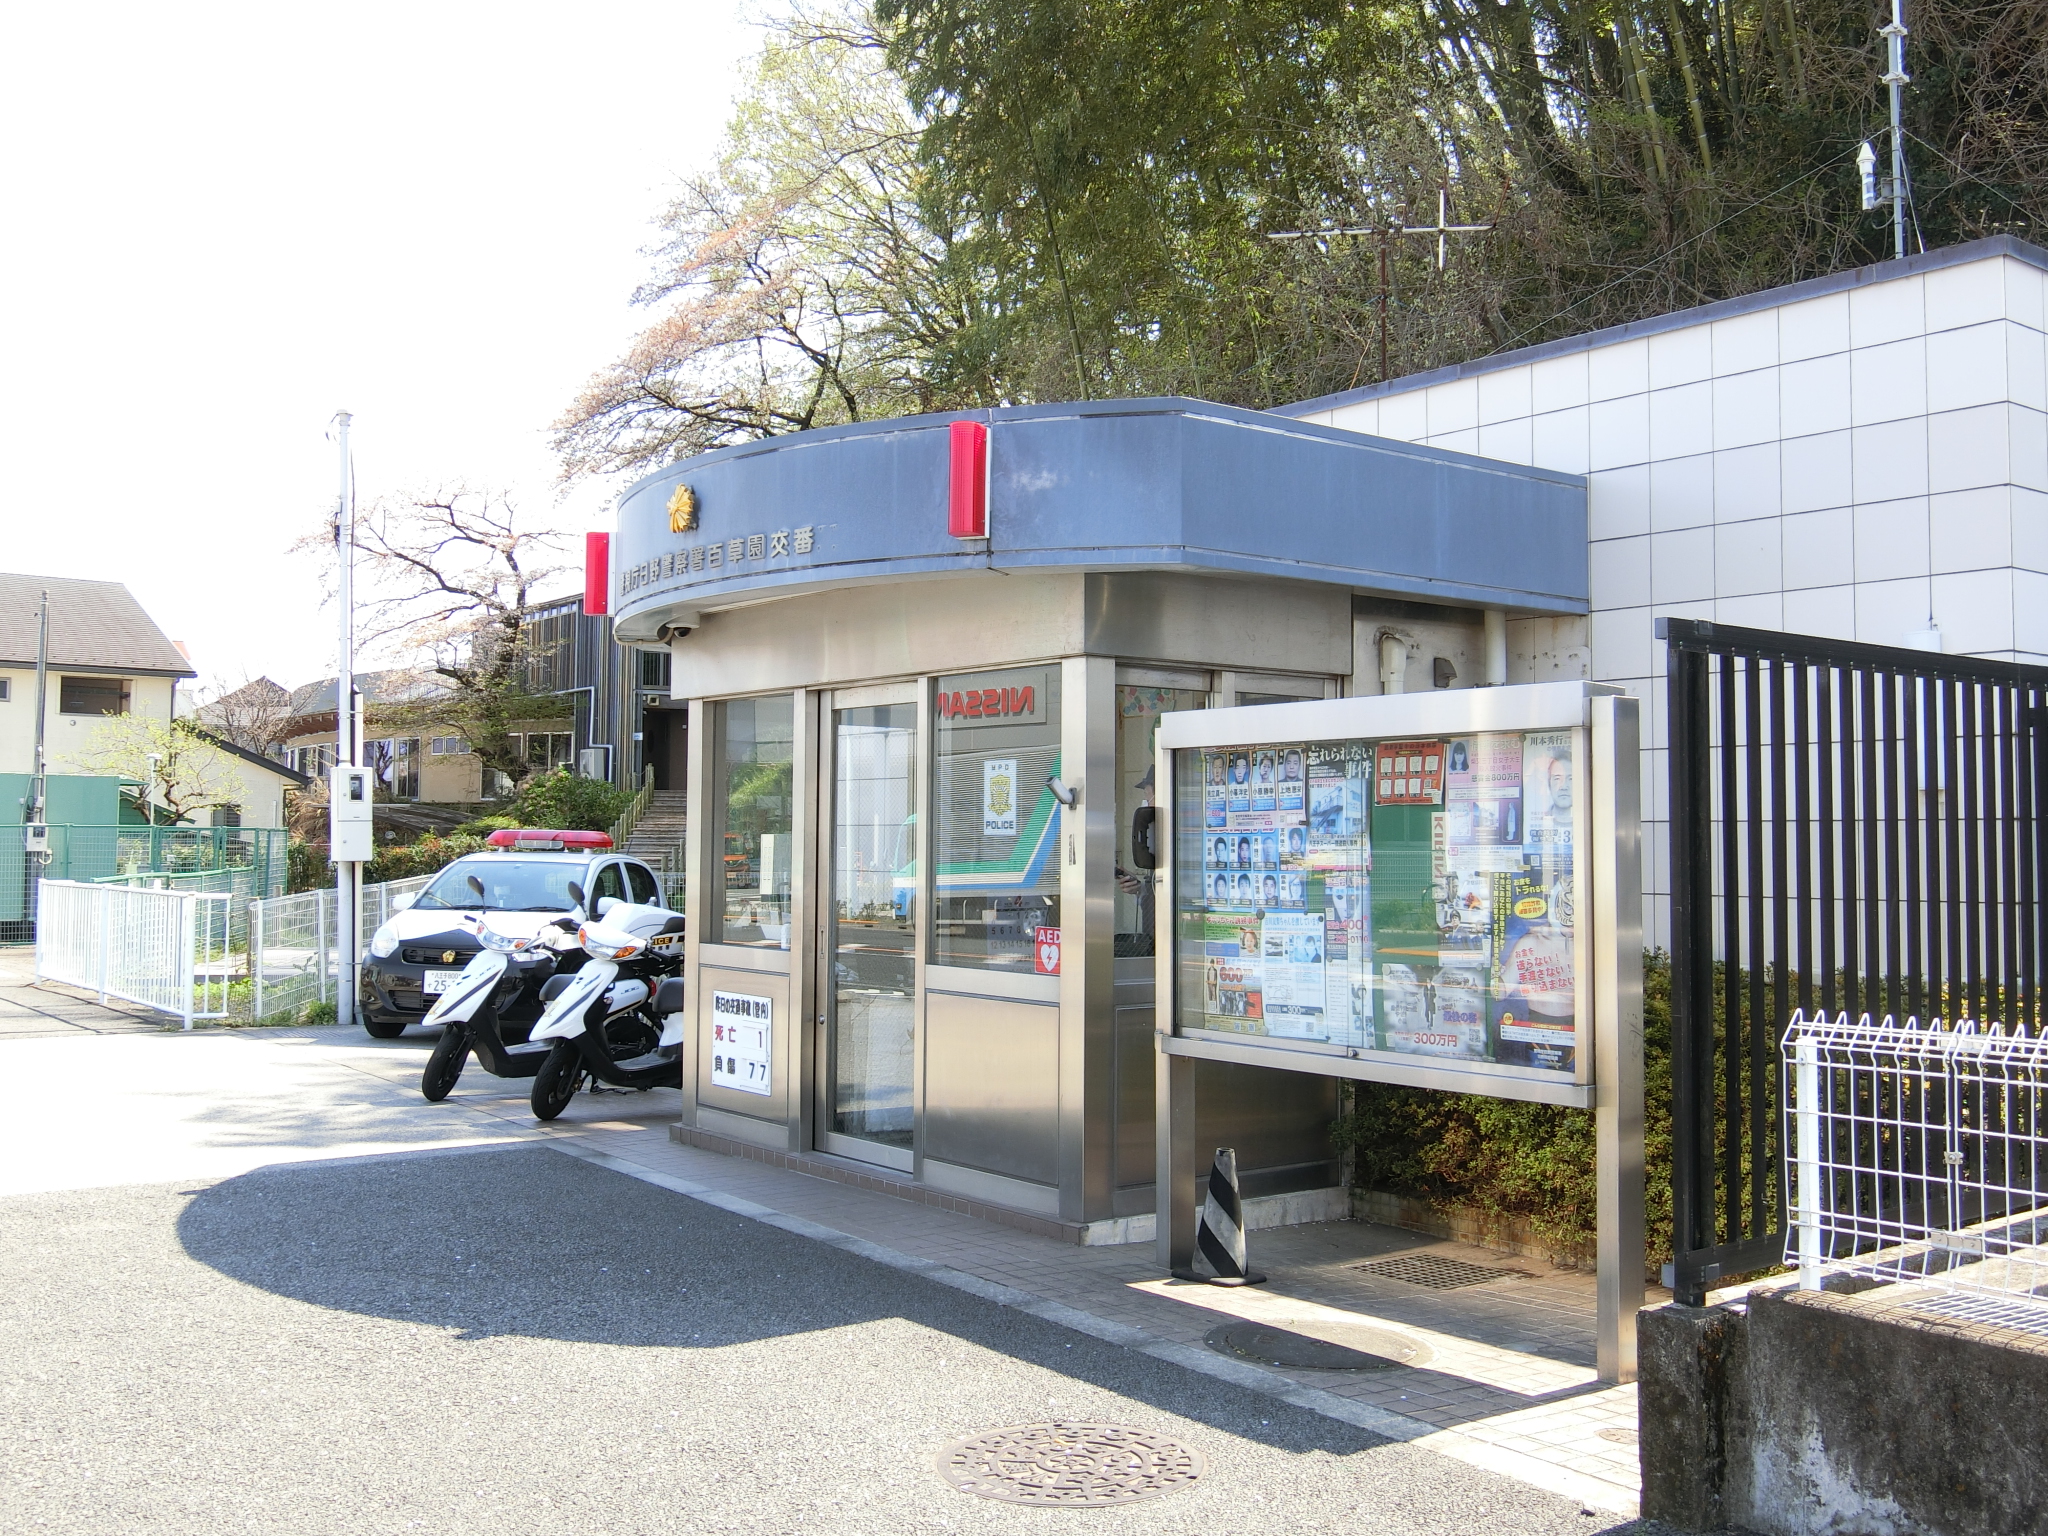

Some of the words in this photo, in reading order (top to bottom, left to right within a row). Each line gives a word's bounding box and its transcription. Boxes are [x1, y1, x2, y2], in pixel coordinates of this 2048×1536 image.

[1307, 745, 1373, 765] 忘れられない
[1345, 761, 1372, 779] 事件
[985, 820, 1015, 830] POLICE
[1000, 927, 1005, 935] 6
[1037, 929, 1061, 944] AED
[447, 972, 459, 980] 800
[1520, 976, 1575, 996] り込まない
[715, 1024, 737, 1044] 死亡
[758, 1030, 762, 1049] 1
[1413, 1032, 1458, 1048] 300万円
[748, 1062, 767, 1082] 77
